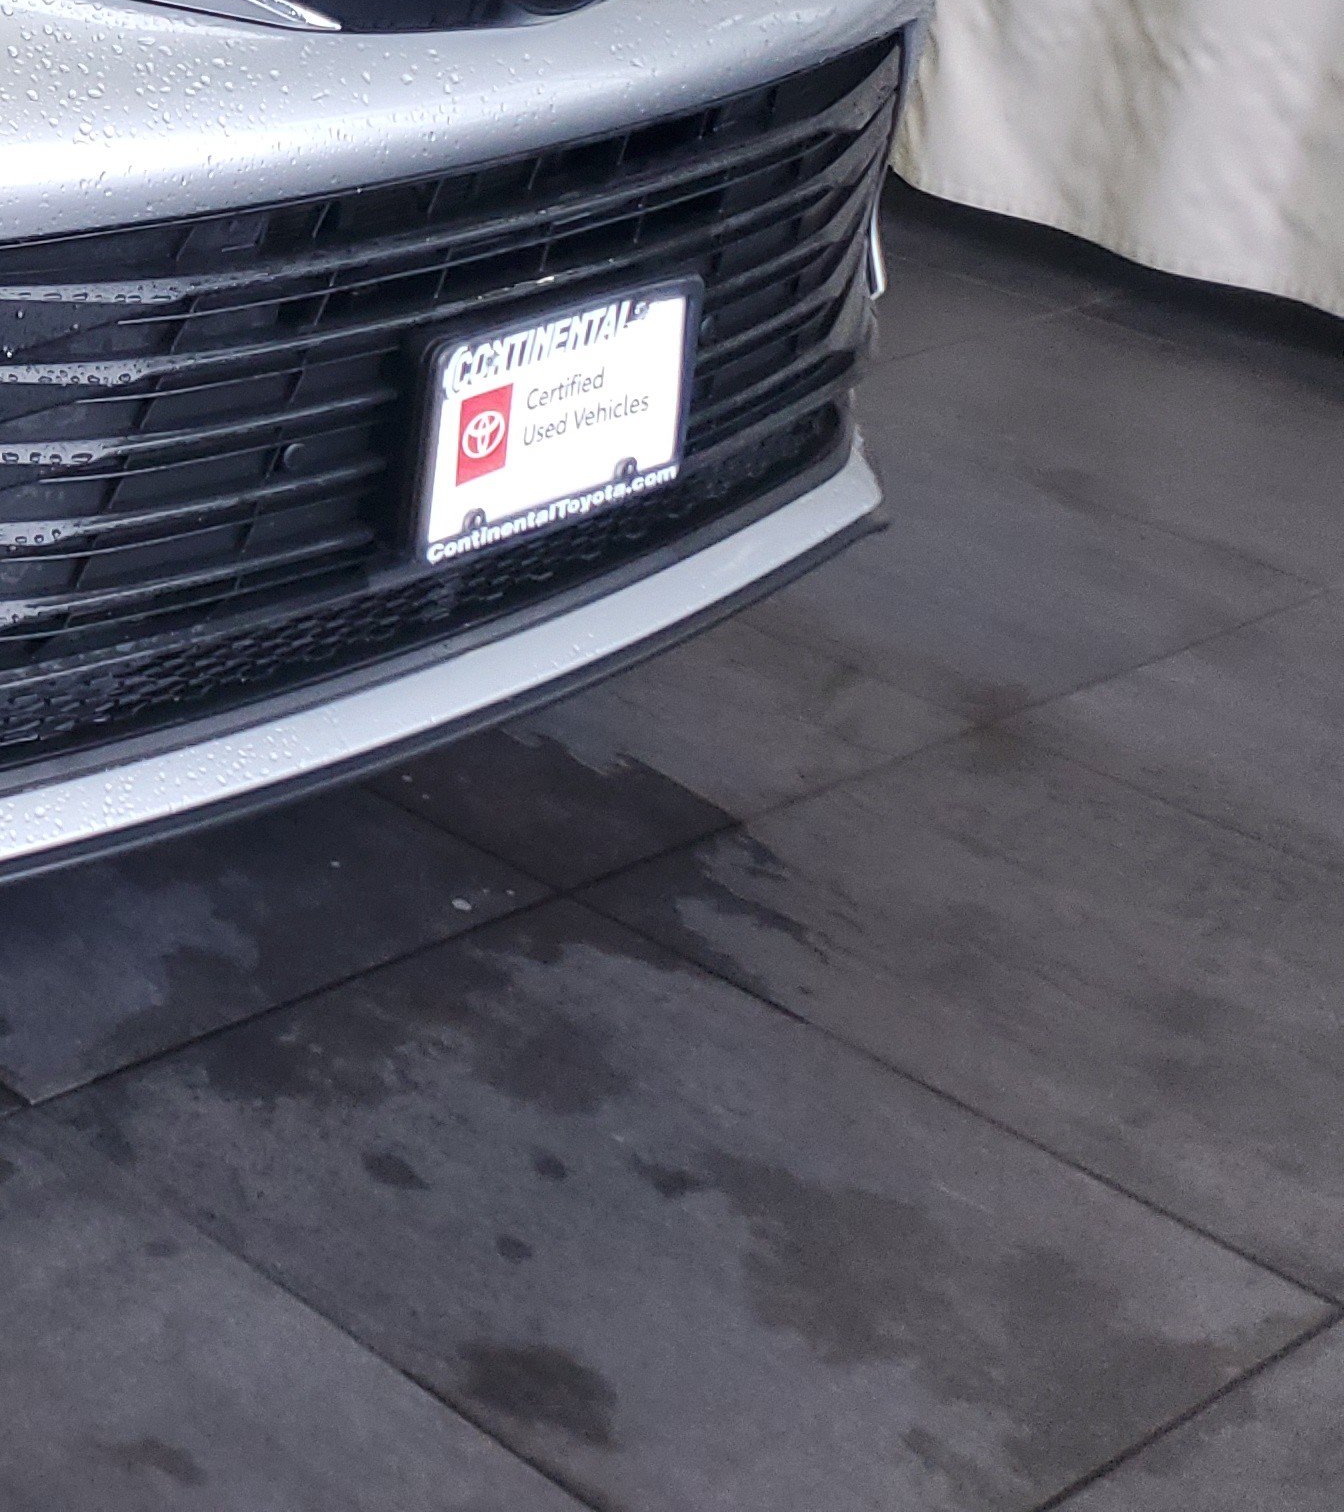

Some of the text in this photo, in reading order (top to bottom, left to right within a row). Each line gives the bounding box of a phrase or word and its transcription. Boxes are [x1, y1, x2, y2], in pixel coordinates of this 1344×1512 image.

[444, 300, 636, 397] CONTINENTAL
[522, 393, 650, 447] Used Vehicles
[526, 366, 605, 411] Certified
[426, 464, 678, 565] ContinentalToyota.com
